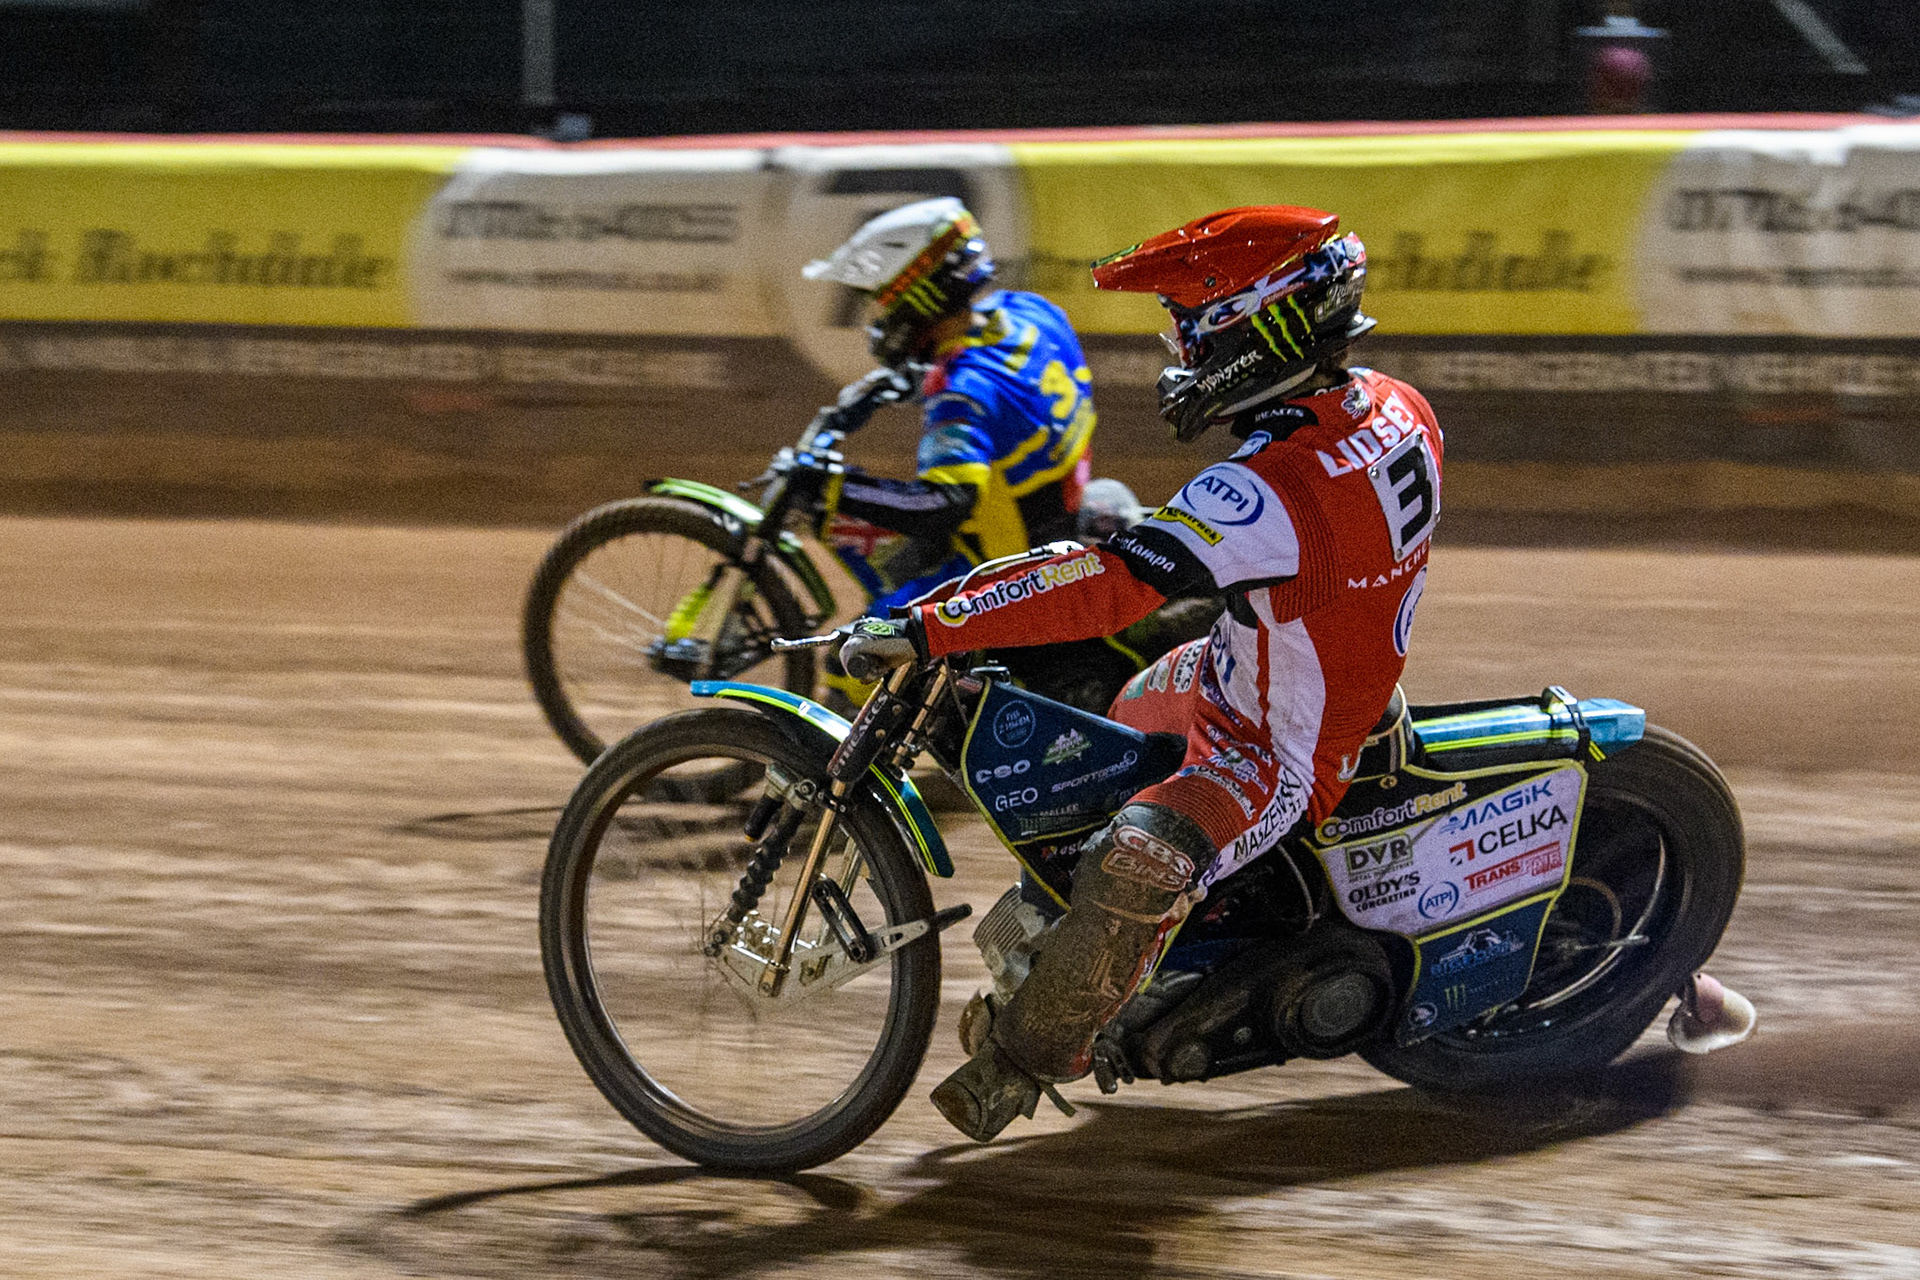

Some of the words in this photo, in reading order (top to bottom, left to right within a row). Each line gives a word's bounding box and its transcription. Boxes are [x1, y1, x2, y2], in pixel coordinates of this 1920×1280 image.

[1196, 350, 1263, 392] MONSTER
[1316, 390, 1415, 478] LIDSEY
[1194, 476, 1249, 512] ATPI
[1387, 446, 1432, 546] 3
[935, 552, 1105, 627] ComfortRent
[996, 787, 1038, 811] GEO
[1315, 782, 1468, 844] ComfortRent
[1478, 804, 1568, 854] CELKA
[1349, 839, 1408, 870] DVR
[1424, 889, 1454, 912] ATPI
